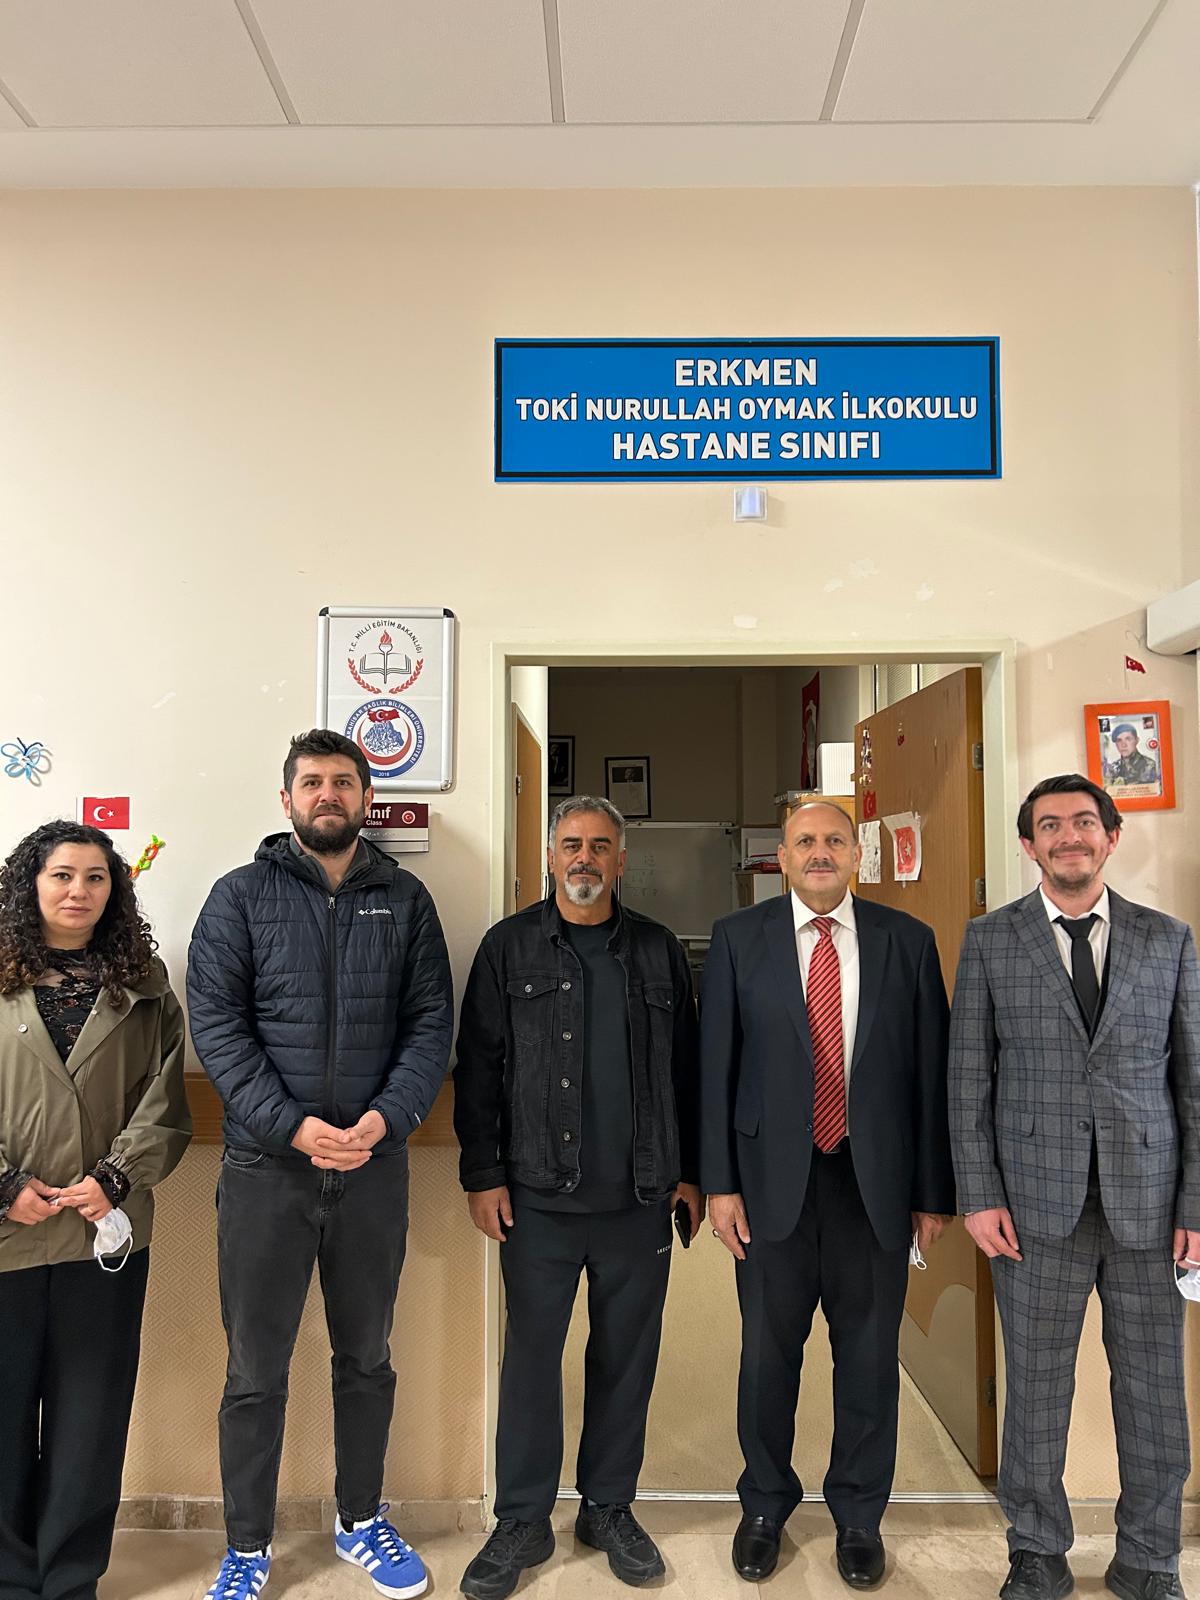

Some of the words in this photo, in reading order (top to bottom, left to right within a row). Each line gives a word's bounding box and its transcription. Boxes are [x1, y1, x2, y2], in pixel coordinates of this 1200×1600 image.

[675, 358, 817, 386] ERKMEN
[516, 392, 578, 421] TOKİ
[585, 396, 732, 421] NURULLAH
[738, 396, 834, 420] OYMAK
[841, 390, 978, 420] İLKOKULU
[612, 431, 770, 460] HASTANE
[779, 430, 880, 460] SINIFI
[354, 623, 372, 641] MİLLİ
[372, 619, 397, 629] EĞİTİM
[396, 623, 424, 654] BAKANLIĞI
[367, 806, 392, 819] ınıf
[365, 908, 392, 916] Columbia
